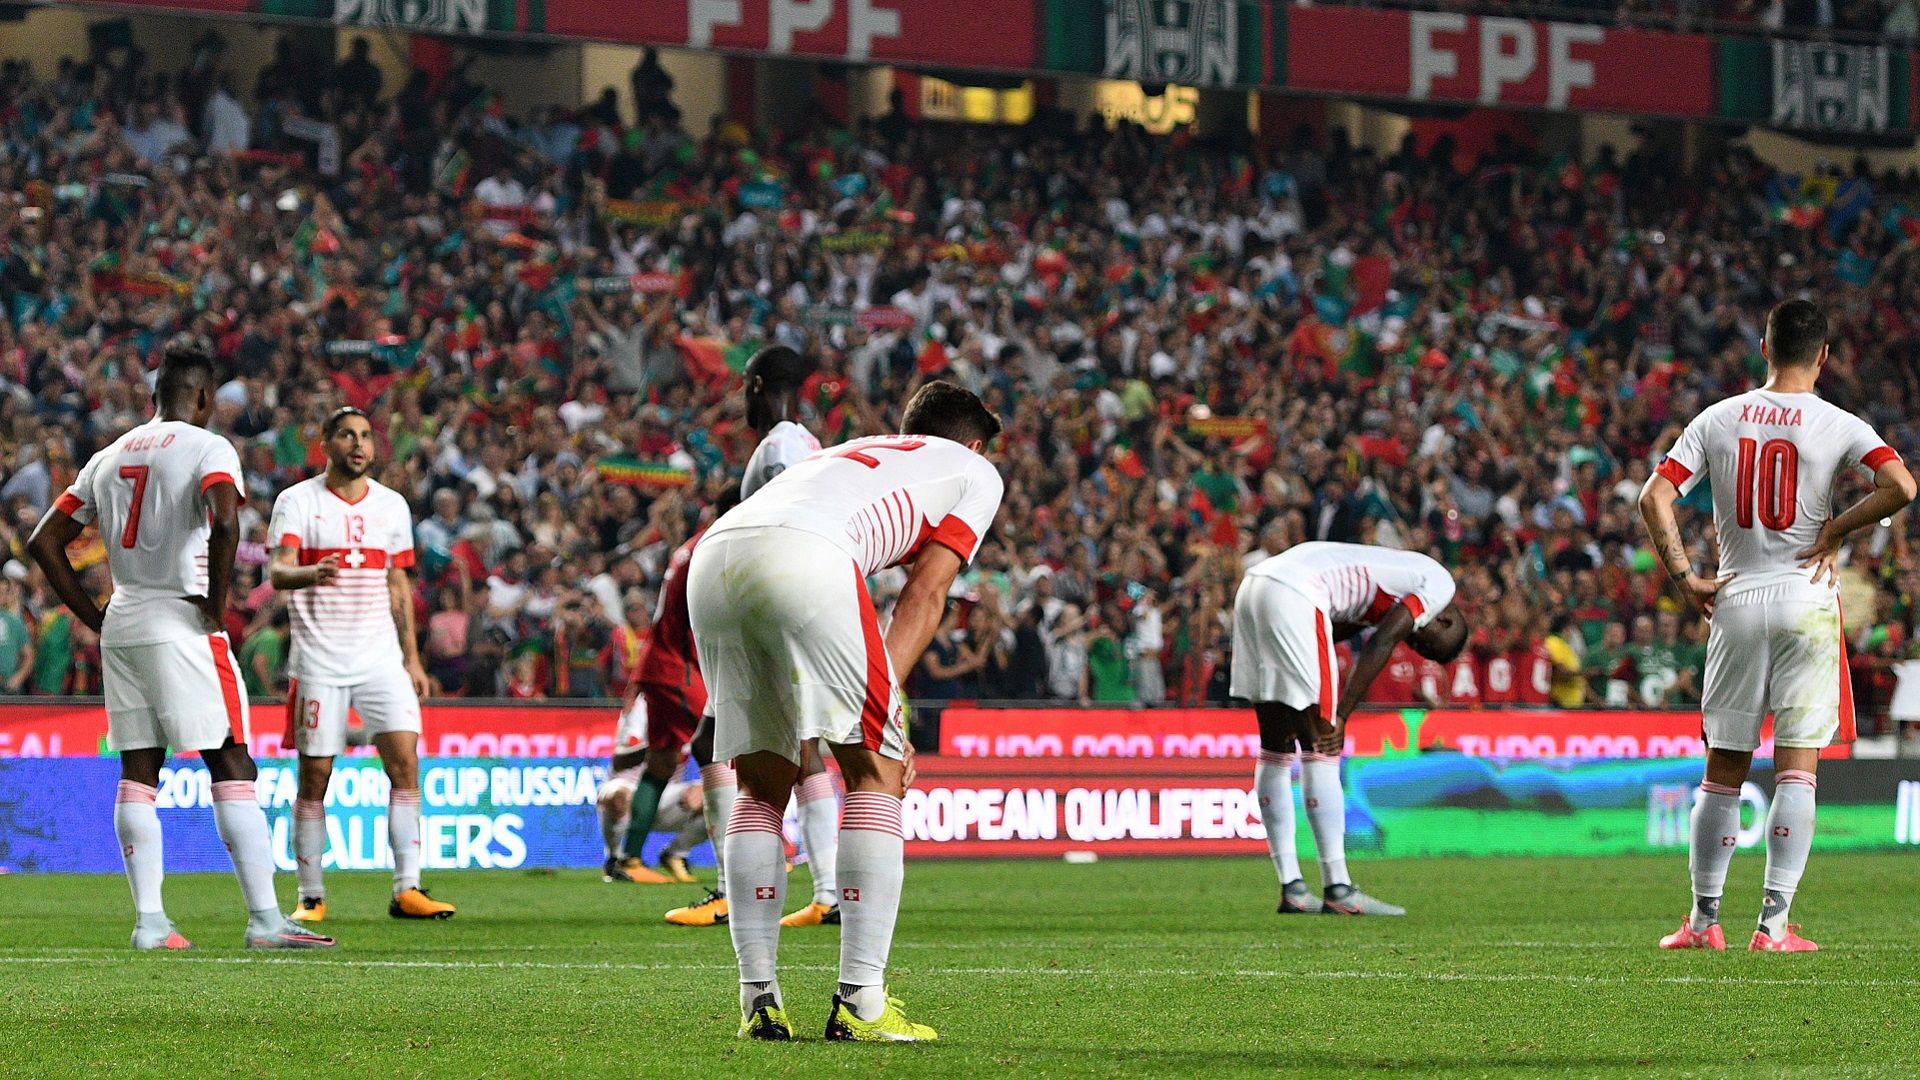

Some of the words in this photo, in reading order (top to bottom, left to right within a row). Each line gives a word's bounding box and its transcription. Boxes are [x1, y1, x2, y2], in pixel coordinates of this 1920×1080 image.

[1408, 9, 1606, 112] FPF
[1738, 404, 1802, 427] XHAKA
[118, 464, 150, 549] 7
[1736, 437, 1799, 532] 10
[344, 514, 366, 544] 13
[300, 698, 321, 729] 13
[155, 767, 214, 809] 201
[423, 766, 489, 807] CUP
[903, 787, 1057, 841] ROPEAN
